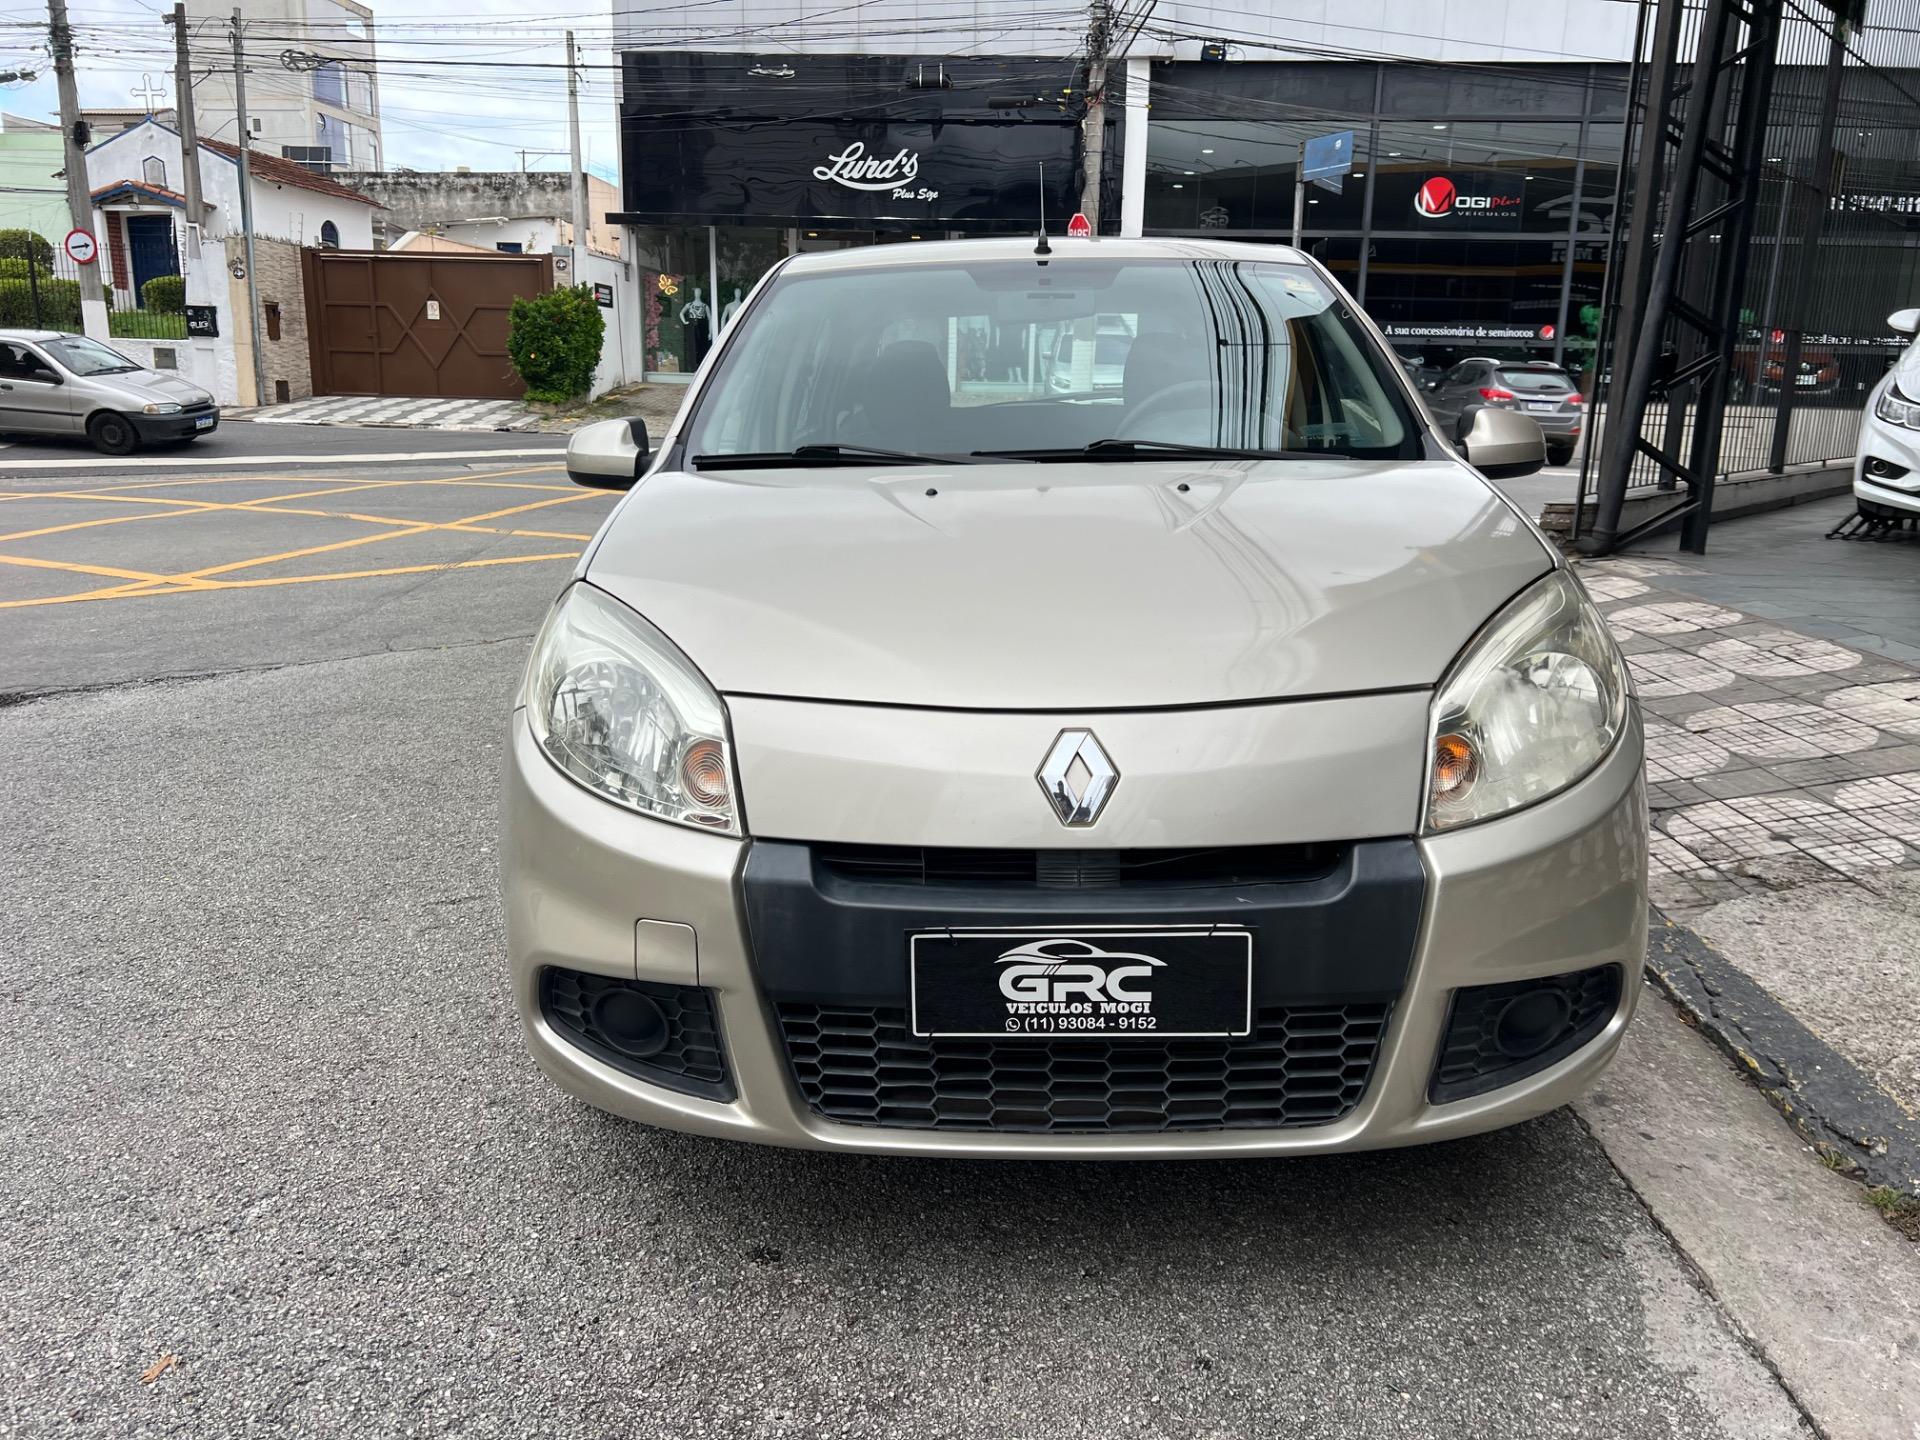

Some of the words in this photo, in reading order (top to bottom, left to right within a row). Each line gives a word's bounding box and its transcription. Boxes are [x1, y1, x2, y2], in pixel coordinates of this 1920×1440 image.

[813, 141, 919, 190] Lurd's
[892, 188, 915, 200] Plus
[917, 188, 939, 201] Size
[1420, 184, 1491, 211] MOGI
[1384, 325, 1393, 335] A
[1394, 327, 1409, 335] sua
[1410, 326, 1474, 337] concessionária
[1476, 326, 1487, 337] de
[1488, 326, 1534, 338] seminovos
[998, 964, 1153, 1002] GRC
[1005, 1002, 1092, 1014] VEICULOS
[1100, 1002, 1150, 1014] MOGI
[1024, 1016, 1055, 1032] (11)
[1058, 1017, 1106, 1030] 93084
[1118, 1017, 1157, 1030] 9152
